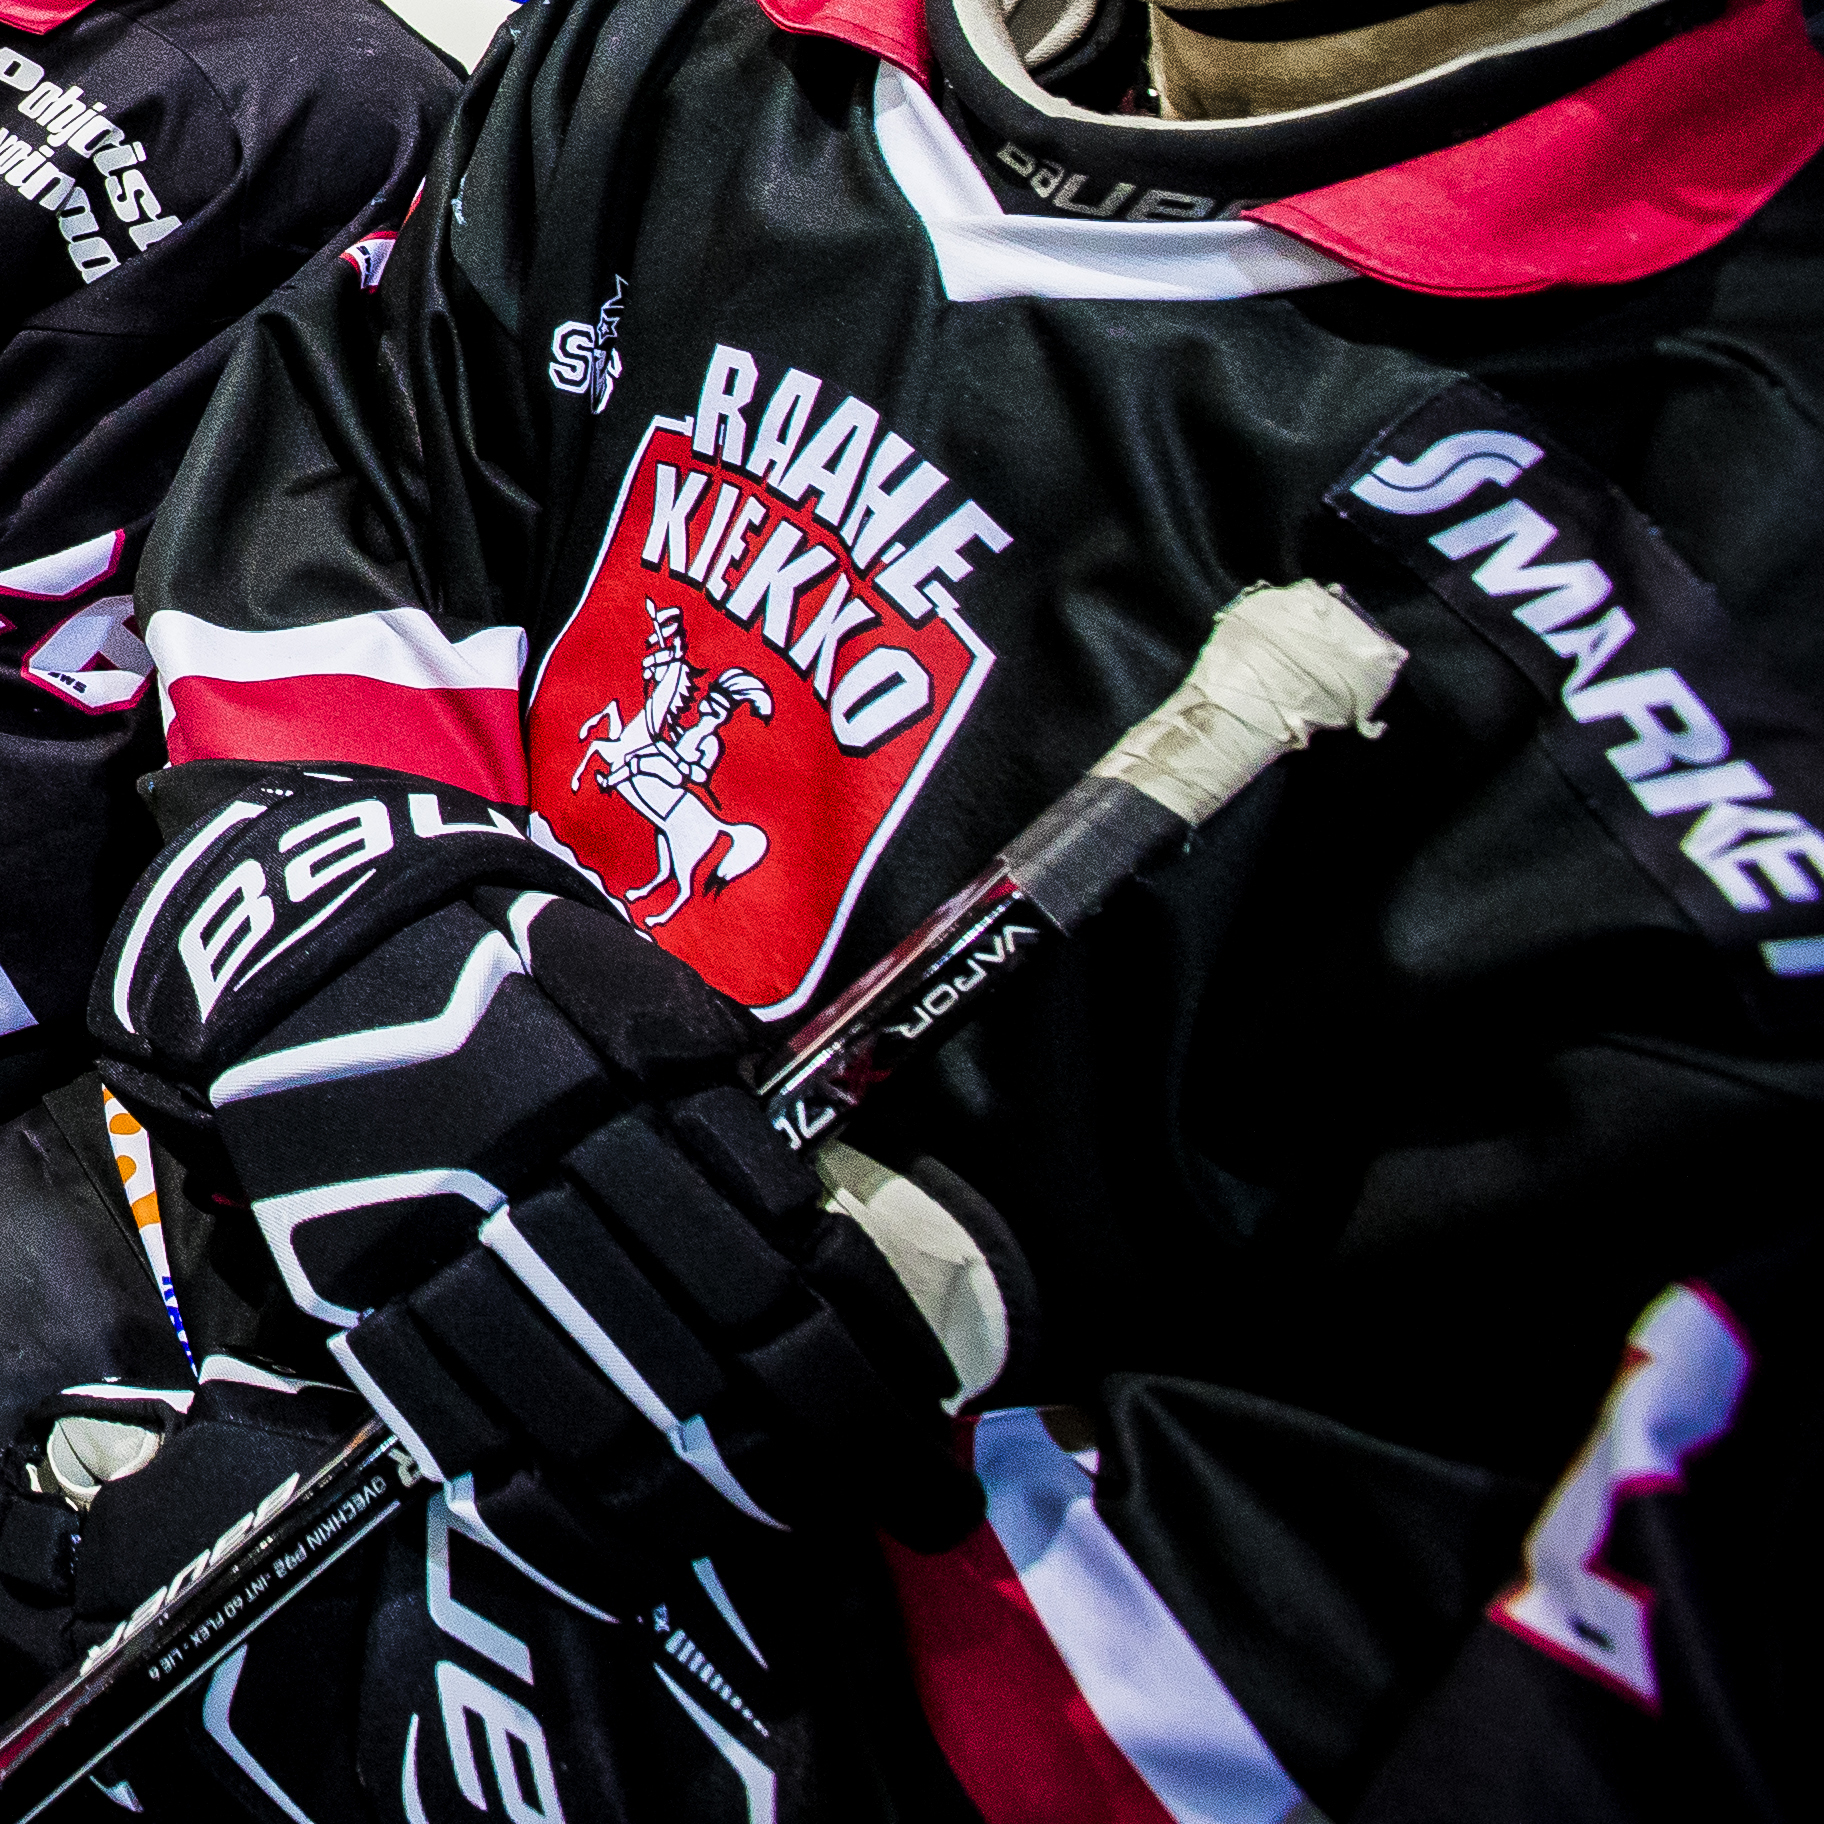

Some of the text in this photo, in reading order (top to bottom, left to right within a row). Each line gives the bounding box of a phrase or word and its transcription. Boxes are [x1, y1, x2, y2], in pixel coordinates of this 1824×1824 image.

[995, 139, 1249, 223] BAUE
[692, 344, 1014, 622] RAAHE
[641, 462, 931, 750] KIEKKO
[882, 923, 1041, 1040] VAPOR
[309, 1475, 387, 1551] OVECHKIN
[191, 1609, 227, 1647] FLEX
[224, 1595, 244, 1619] 60
[160, 1642, 184, 1674] LIE
